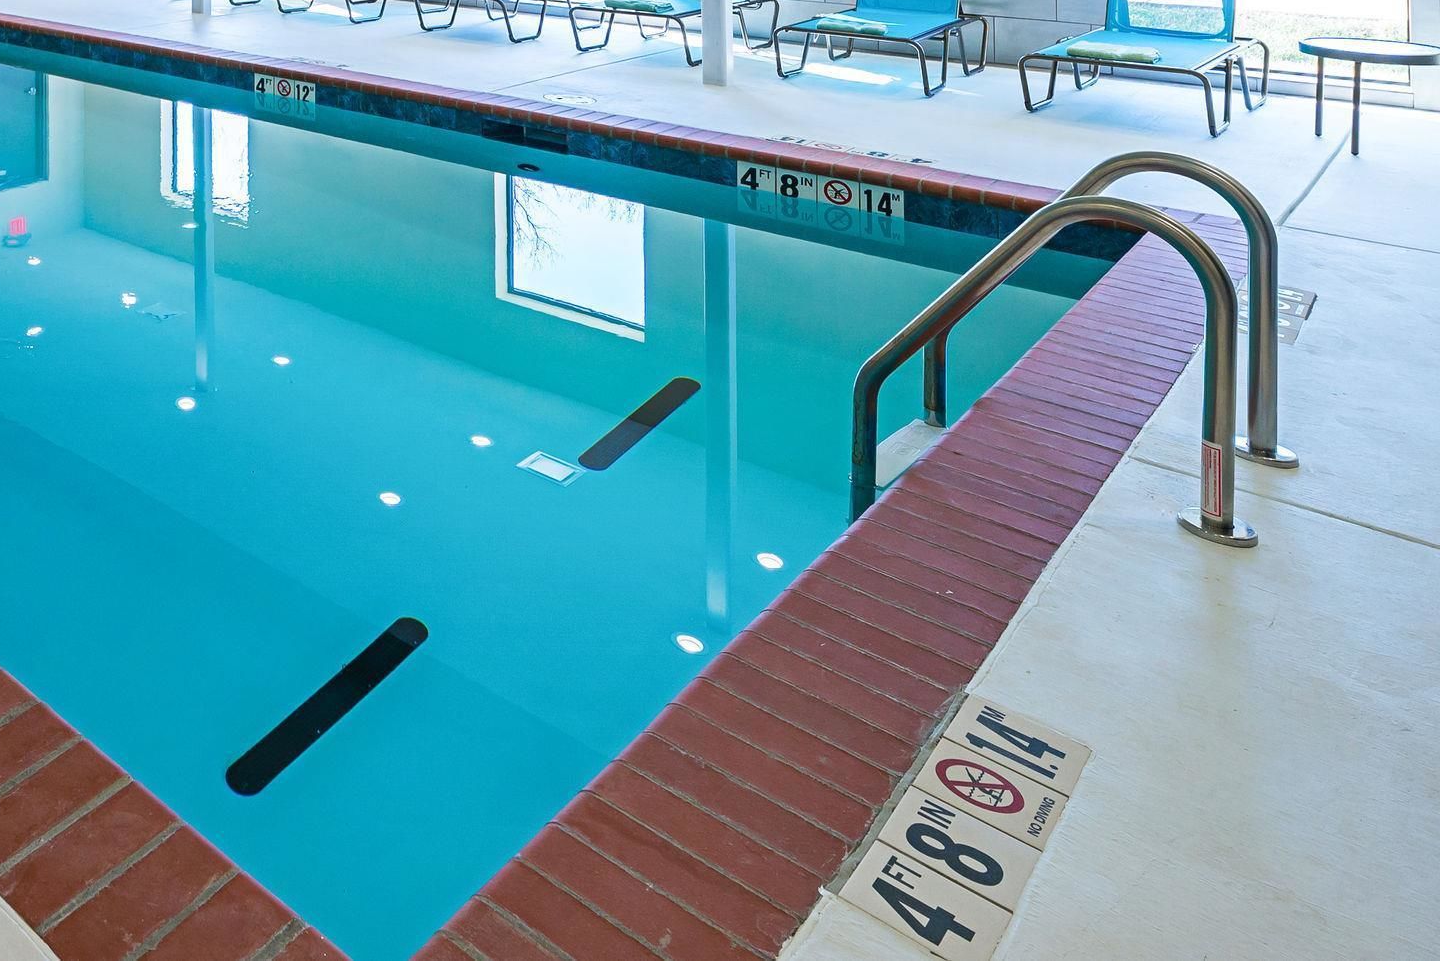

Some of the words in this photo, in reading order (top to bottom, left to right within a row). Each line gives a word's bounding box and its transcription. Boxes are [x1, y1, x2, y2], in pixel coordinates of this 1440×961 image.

[255, 77, 266, 94] 4
[296, 84, 310, 103] 12
[740, 166, 760, 191] 4
[760, 168, 772, 180] FT
[779, 174, 799, 198] 8
[800, 176, 813, 188] IN
[891, 193, 901, 202] M
[980, 704, 1007, 723] M
[964, 713, 1067, 780] 1.4
[917, 798, 957, 830] IN
[1034, 796, 1056, 825] DIVING
[1026, 822, 1043, 838] NO
[905, 822, 1004, 887] 8
[881, 855, 922, 890] FT
[871, 877, 976, 947] 4
